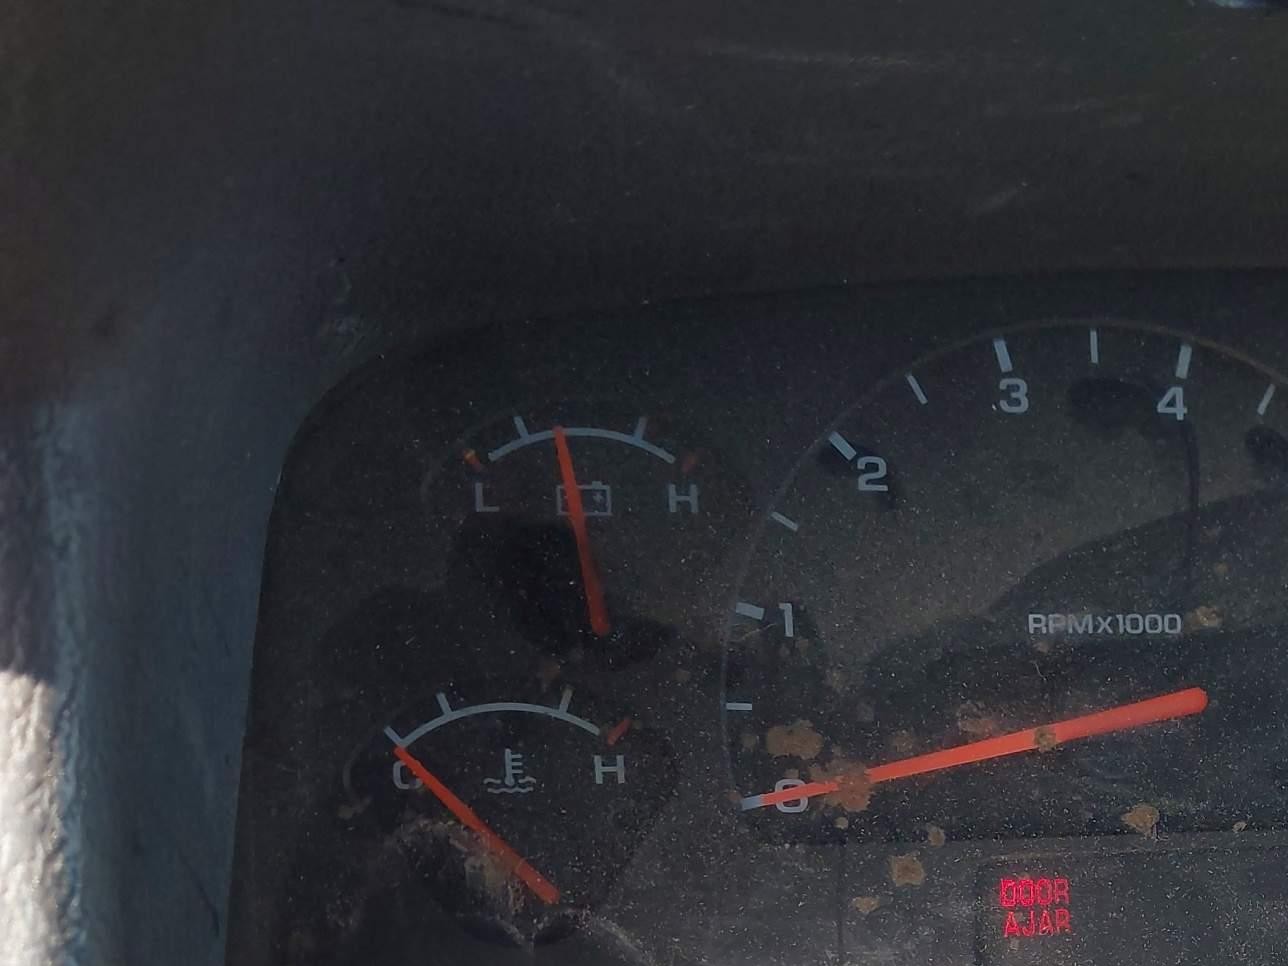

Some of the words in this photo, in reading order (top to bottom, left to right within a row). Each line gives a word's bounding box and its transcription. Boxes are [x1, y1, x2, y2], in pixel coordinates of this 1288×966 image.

[999, 377, 1030, 414] 3
[1156, 385, 1188, 421] 4
[857, 455, 889, 492] 2
[475, 483, 500, 512] L
[668, 484, 699, 513] H
[778, 602, 794, 637] 1
[594, 755, 626, 784] H
[774, 778, 809, 814] 0
[1000, 876, 1070, 908] DOOR
[1004, 908, 1072, 937] AJAR
